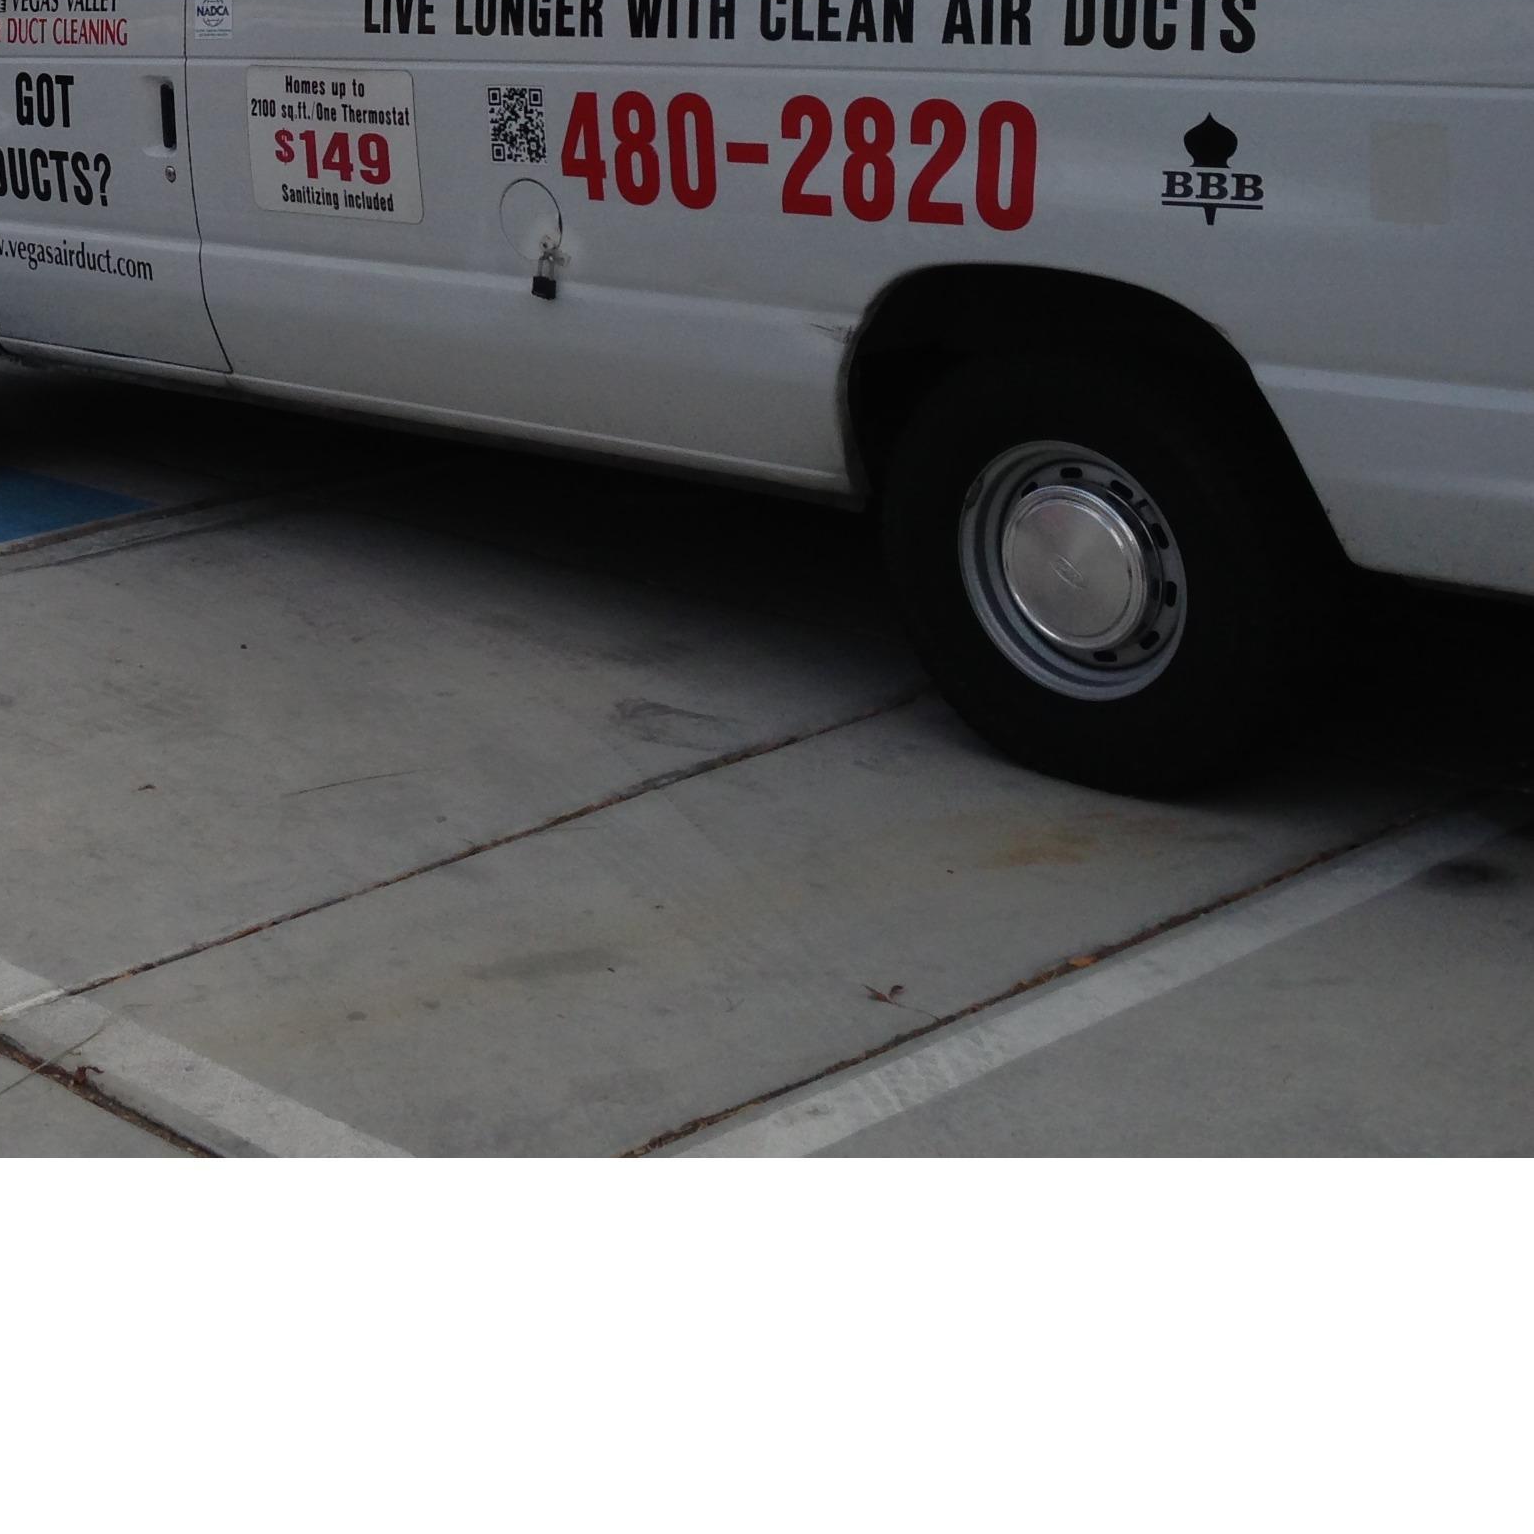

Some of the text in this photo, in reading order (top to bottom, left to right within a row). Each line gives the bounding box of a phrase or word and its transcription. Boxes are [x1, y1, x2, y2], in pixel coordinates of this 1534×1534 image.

[197, 5, 229, 17] NADCA
[7, 18, 47, 44] DUCT
[53, 18, 128, 46] CLEANING
[15, 72, 74, 128] GOT
[285, 75, 365, 99] Homes up to
[251, 98, 276, 117] 2100
[341, 104, 410, 126] Thermostat
[274, 127, 391, 185] $149
[561, 90, 1037, 231] 480-2820
[281, 183, 394, 212] Sanitizing included
[1161, 170, 1264, 201] BBB
